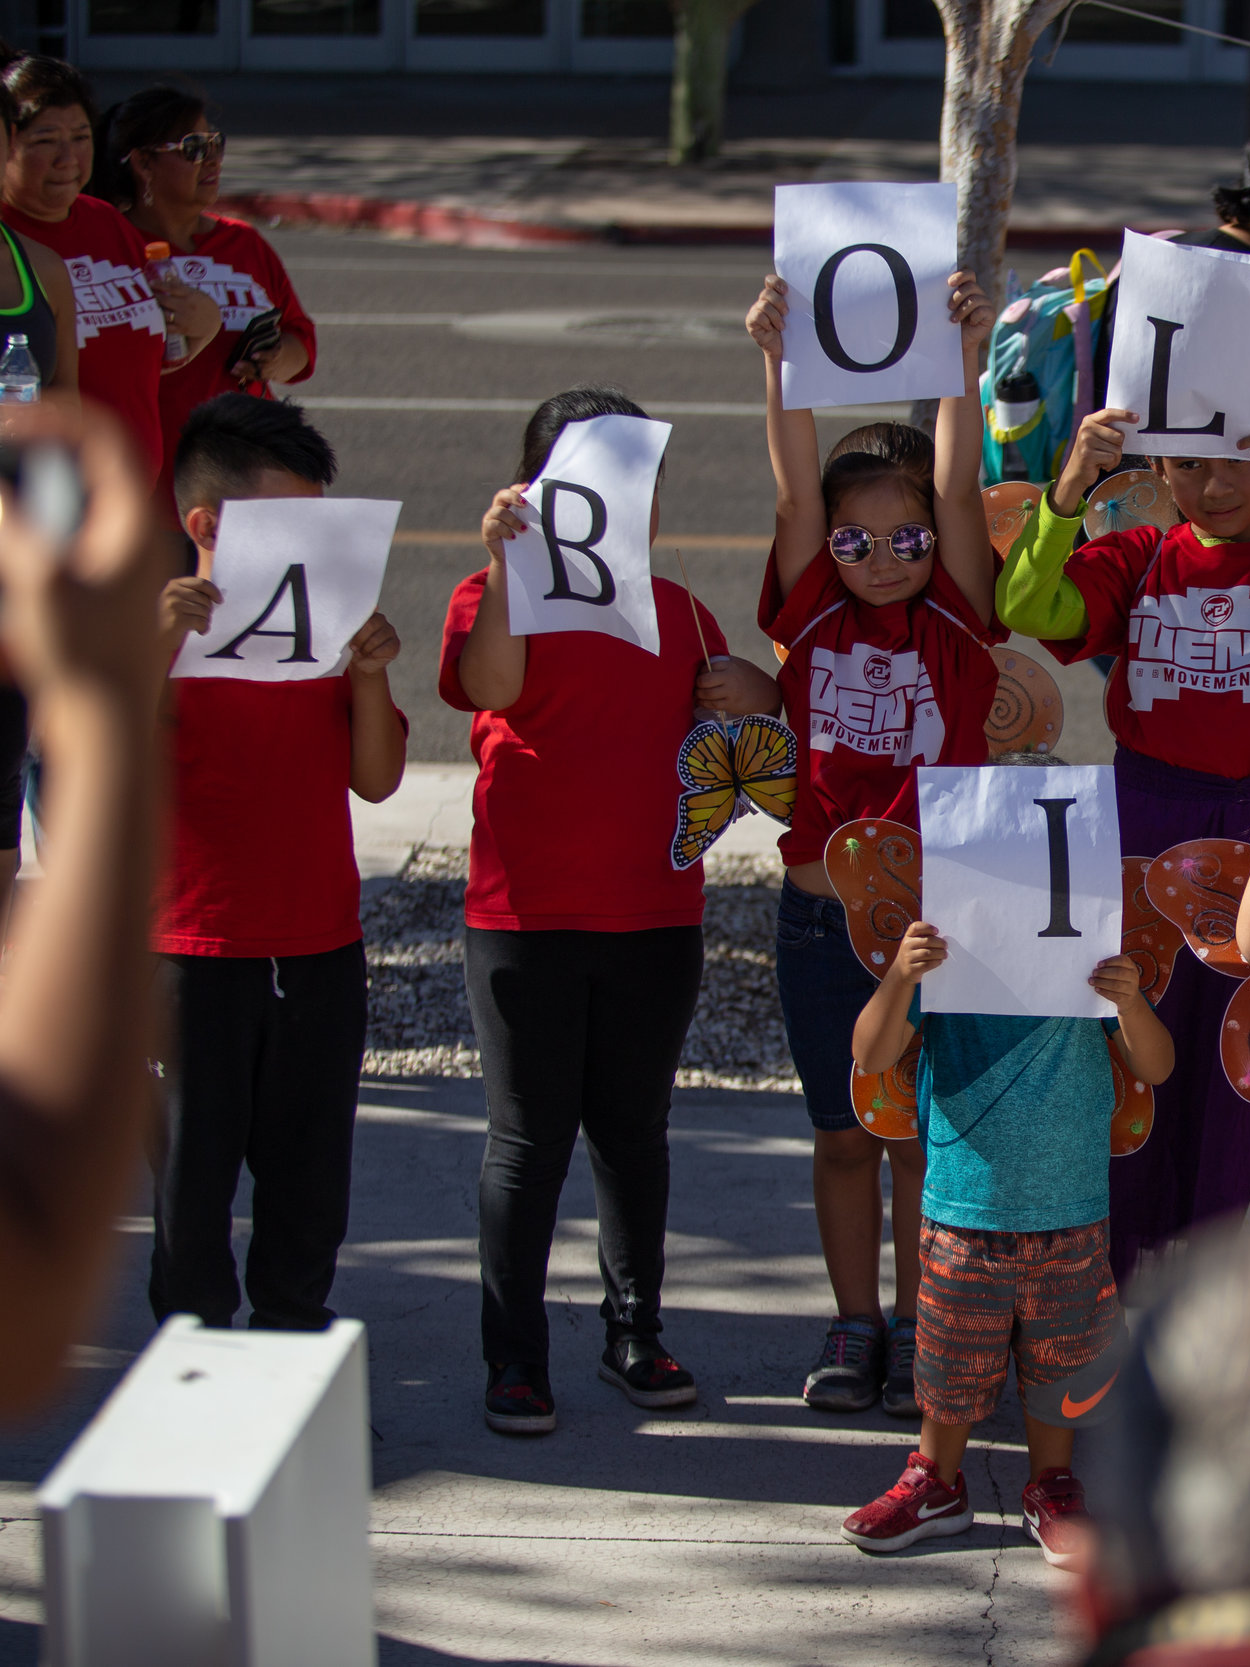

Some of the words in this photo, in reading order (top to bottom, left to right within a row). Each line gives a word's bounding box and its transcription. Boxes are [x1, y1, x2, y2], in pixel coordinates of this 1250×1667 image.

[814, 244, 919, 373] O
[1137, 316, 1226, 437] L
[540, 479, 617, 606] B
[205, 563, 319, 664] A
[820, 718, 910, 752] MOVEMENT
[1033, 798, 1082, 938] I
